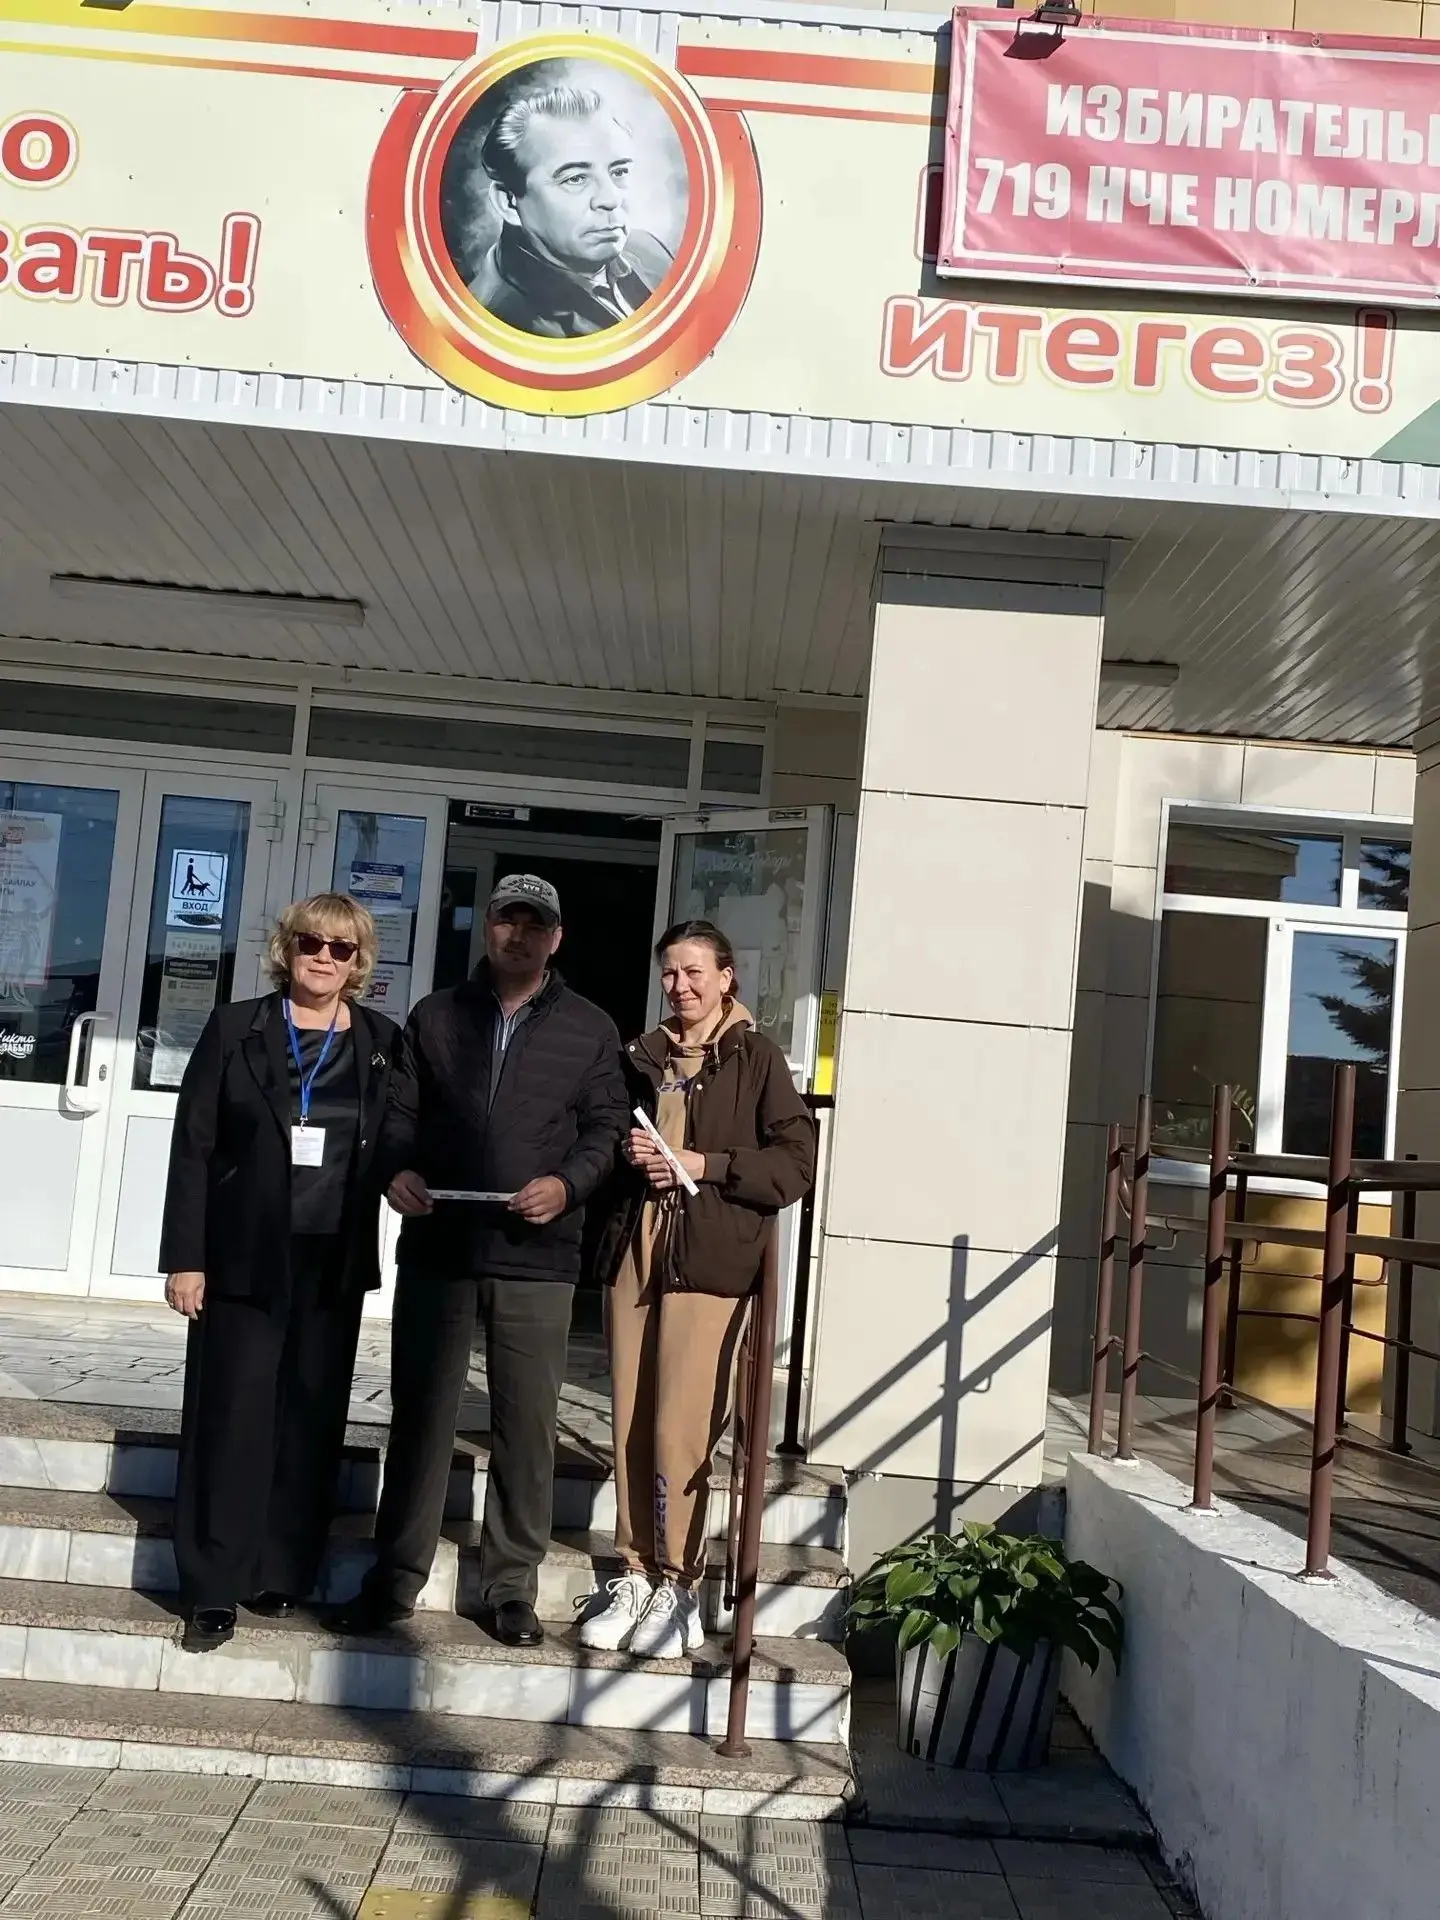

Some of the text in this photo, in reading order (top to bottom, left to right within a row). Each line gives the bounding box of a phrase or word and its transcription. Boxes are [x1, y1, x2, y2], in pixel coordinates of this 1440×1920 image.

[1046, 83, 1440, 167] ИЗБИРАТЕЛЬ
[974, 158, 1071, 219] 719
[1086, 166, 1200, 228] НЧЕ
[0, 214, 259, 316] ать!
[882, 296, 1395, 412] итегез!
[182, 901, 208, 912] ВХОД
